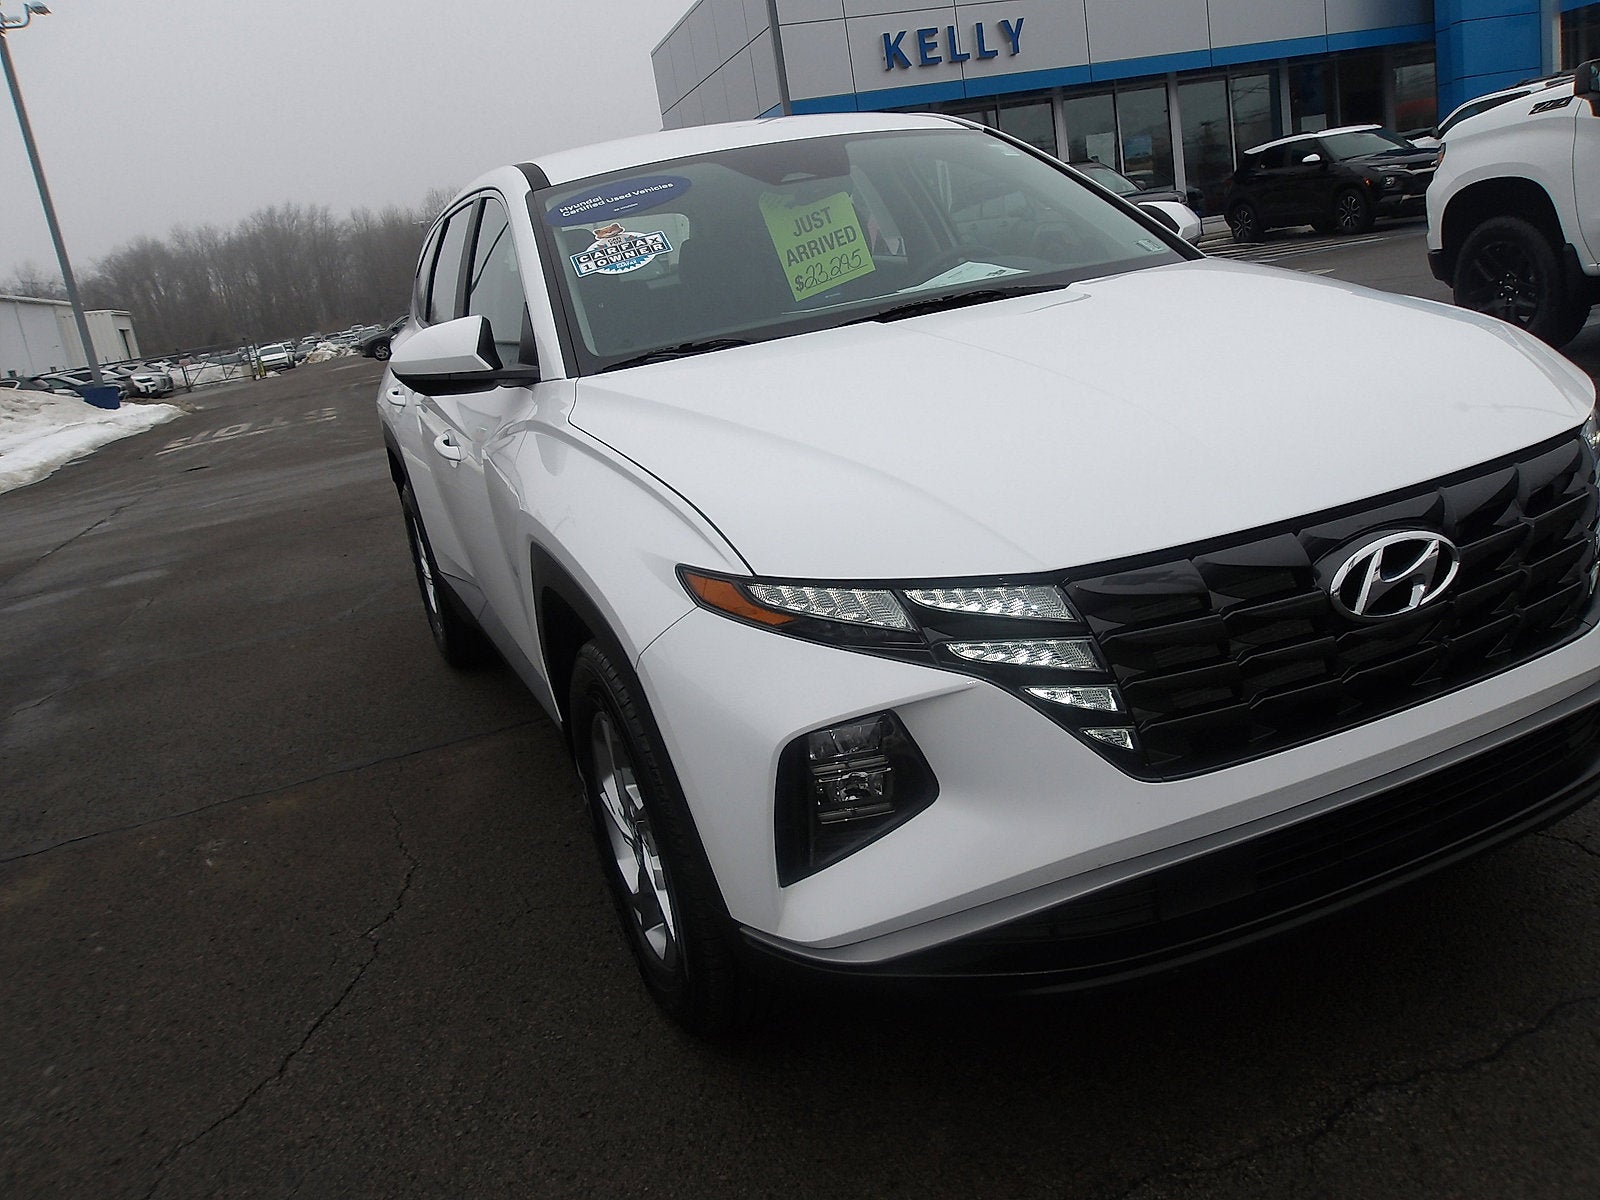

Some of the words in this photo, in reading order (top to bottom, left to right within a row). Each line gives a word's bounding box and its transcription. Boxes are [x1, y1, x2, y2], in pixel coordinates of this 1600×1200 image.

[882, 17, 1024, 71] KELLY
[559, 196, 602, 213] Hyundai
[562, 200, 605, 217] Certified
[606, 192, 632, 203] Used
[632, 182, 674, 196] Vehicles
[793, 206, 832, 237] JUST
[578, 236, 660, 263] CARFAX
[786, 225, 857, 267] ARRIVED
